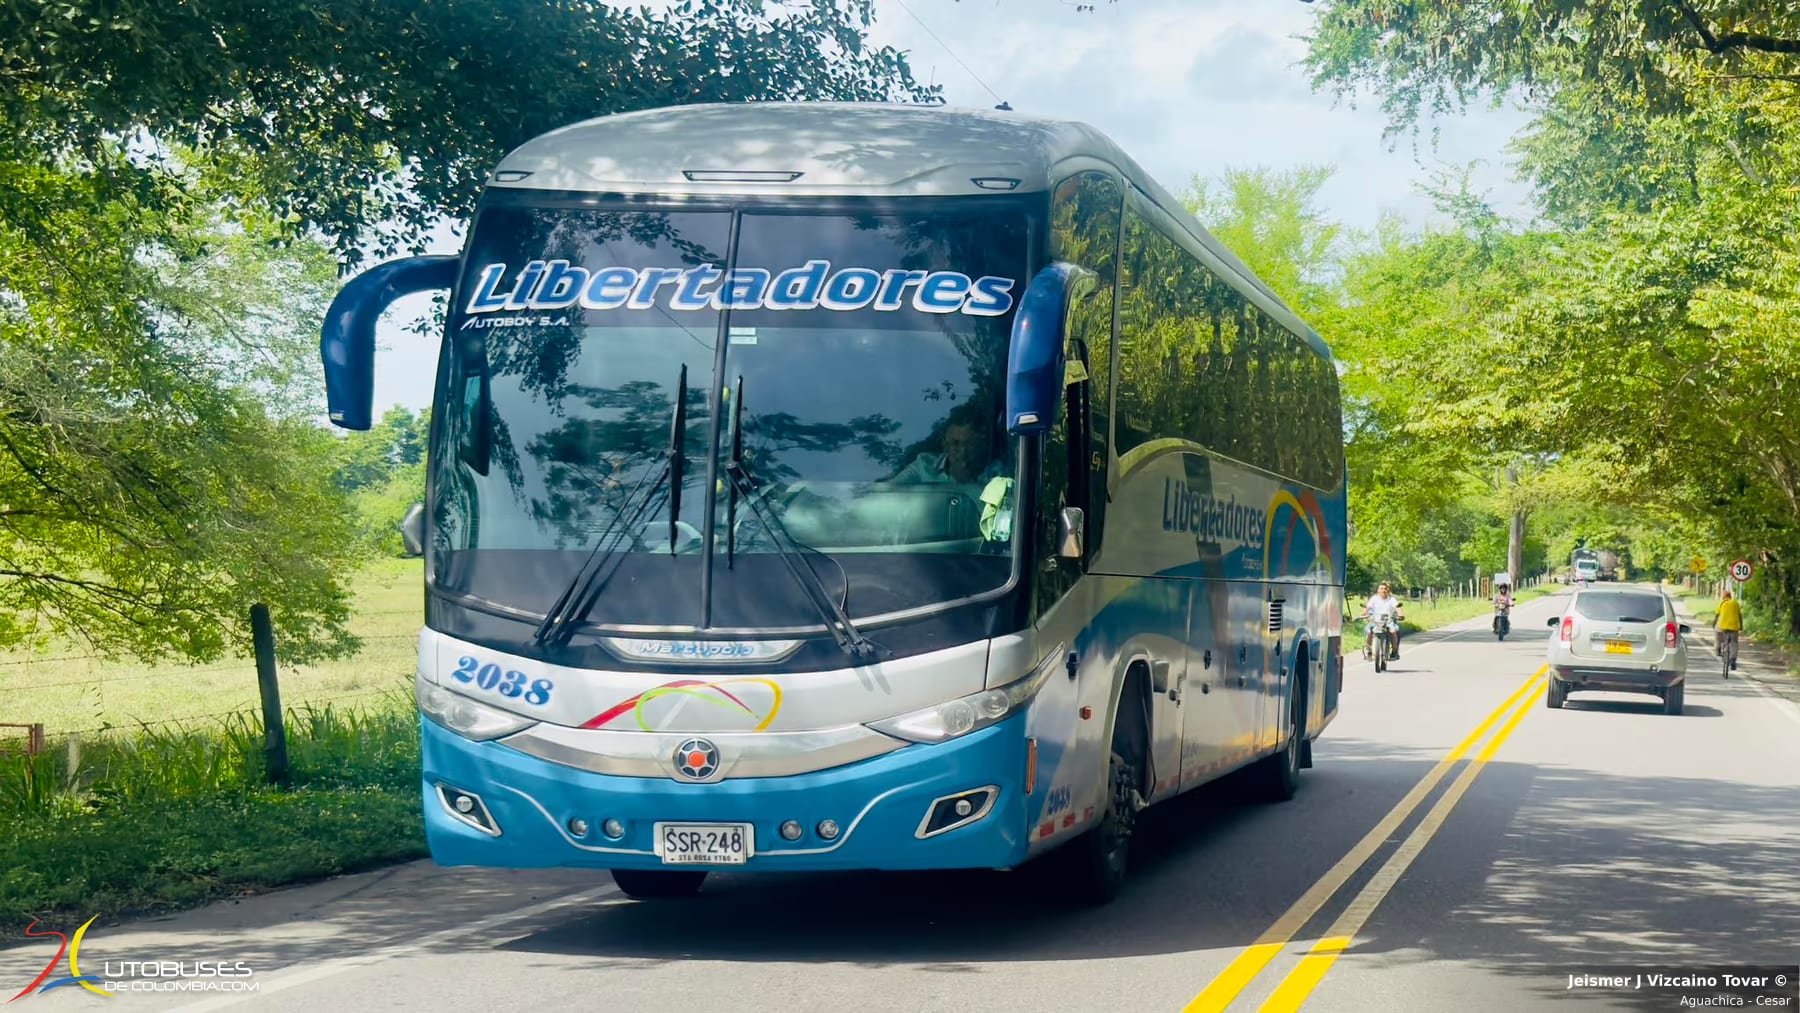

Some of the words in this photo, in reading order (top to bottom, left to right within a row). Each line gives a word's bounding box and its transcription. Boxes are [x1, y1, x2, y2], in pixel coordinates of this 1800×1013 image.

[465, 259, 1015, 316] Libertadores
[538, 317, 570, 327] S.A.
[1161, 476, 1265, 548] Libertadores
[1735, 565, 1749, 576] 30
[451, 655, 554, 705] 2038
